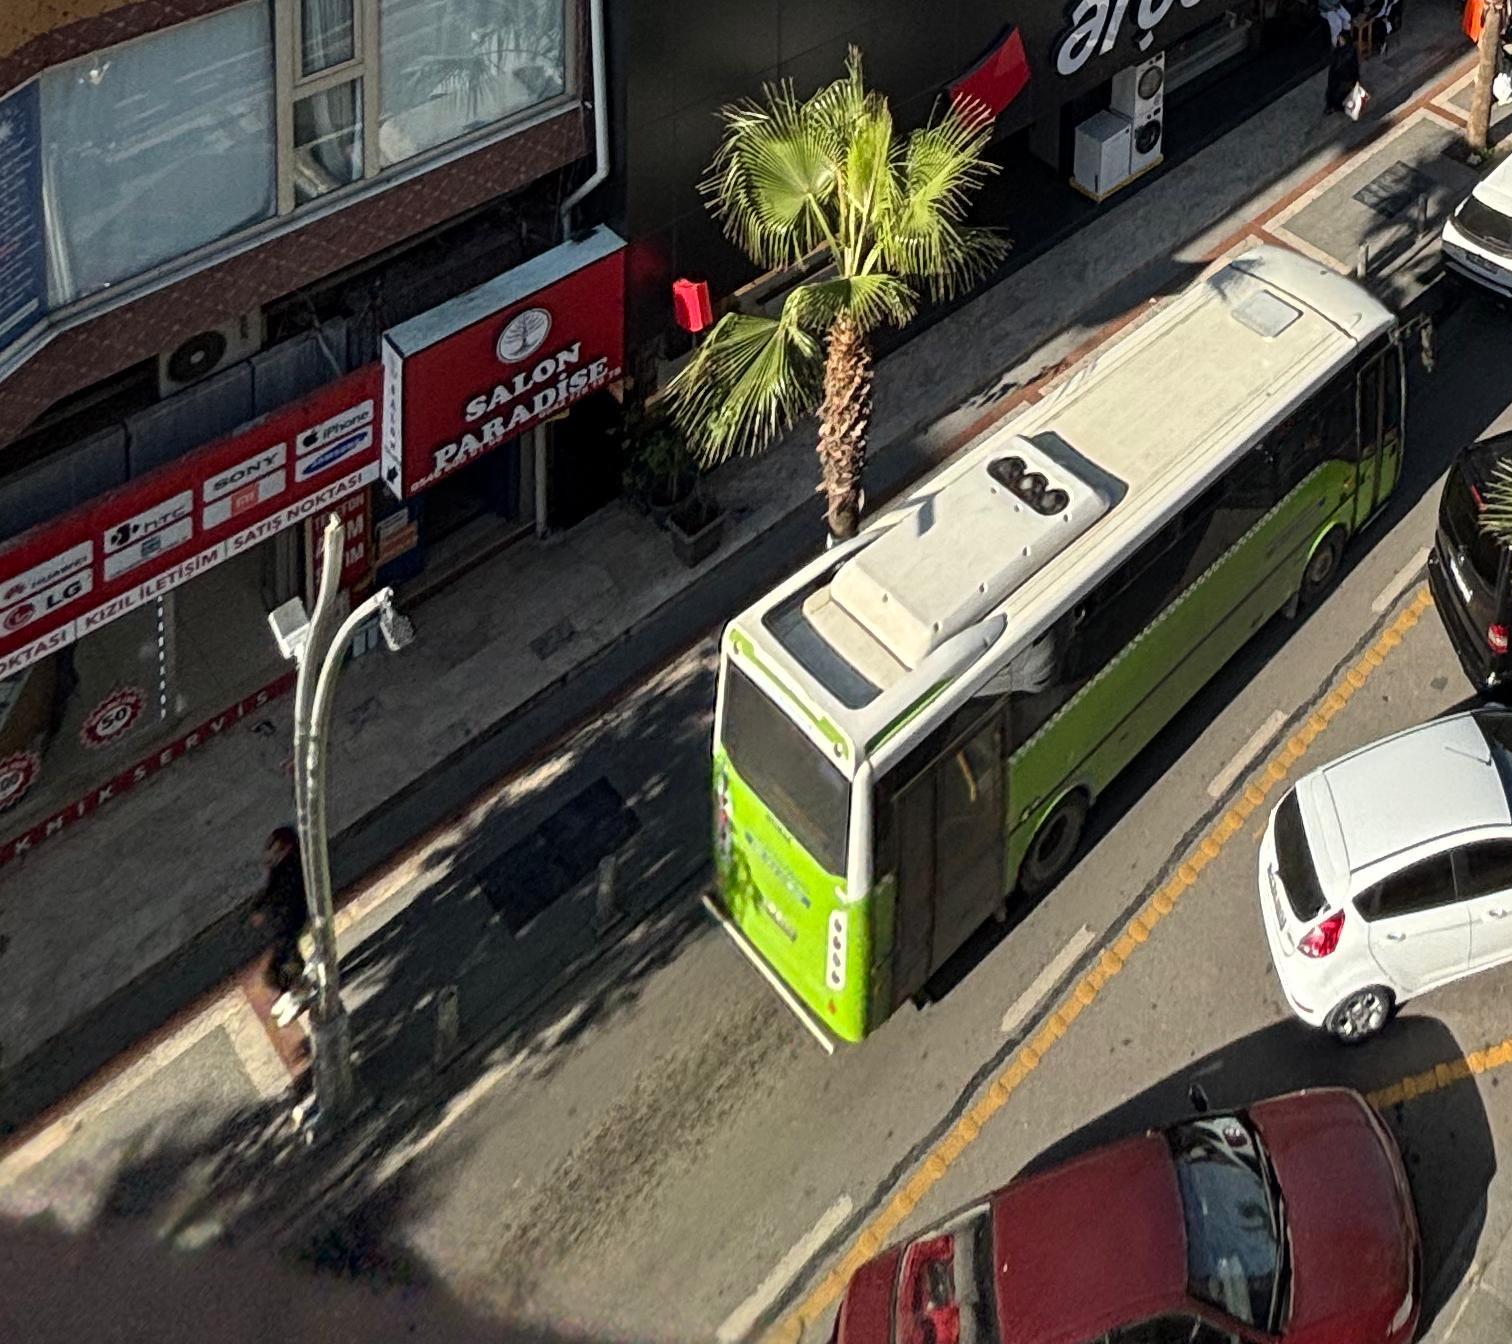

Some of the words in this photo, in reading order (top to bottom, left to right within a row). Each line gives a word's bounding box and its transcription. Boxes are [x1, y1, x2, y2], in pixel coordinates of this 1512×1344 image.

[465, 342, 582, 422] SALON
[322, 411, 369, 440] iPhone
[433, 357, 608, 475] PARADİSE
[212, 451, 280, 492] SONY
[85, 595, 136, 630] KIZIL
[139, 549, 219, 601] İLETİŞİM
[233, 514, 283, 551] SATIŞ
[287, 472, 363, 522] NOKTASI
[46, 580, 83, 610] LG
[101, 706, 128, 730] 50
